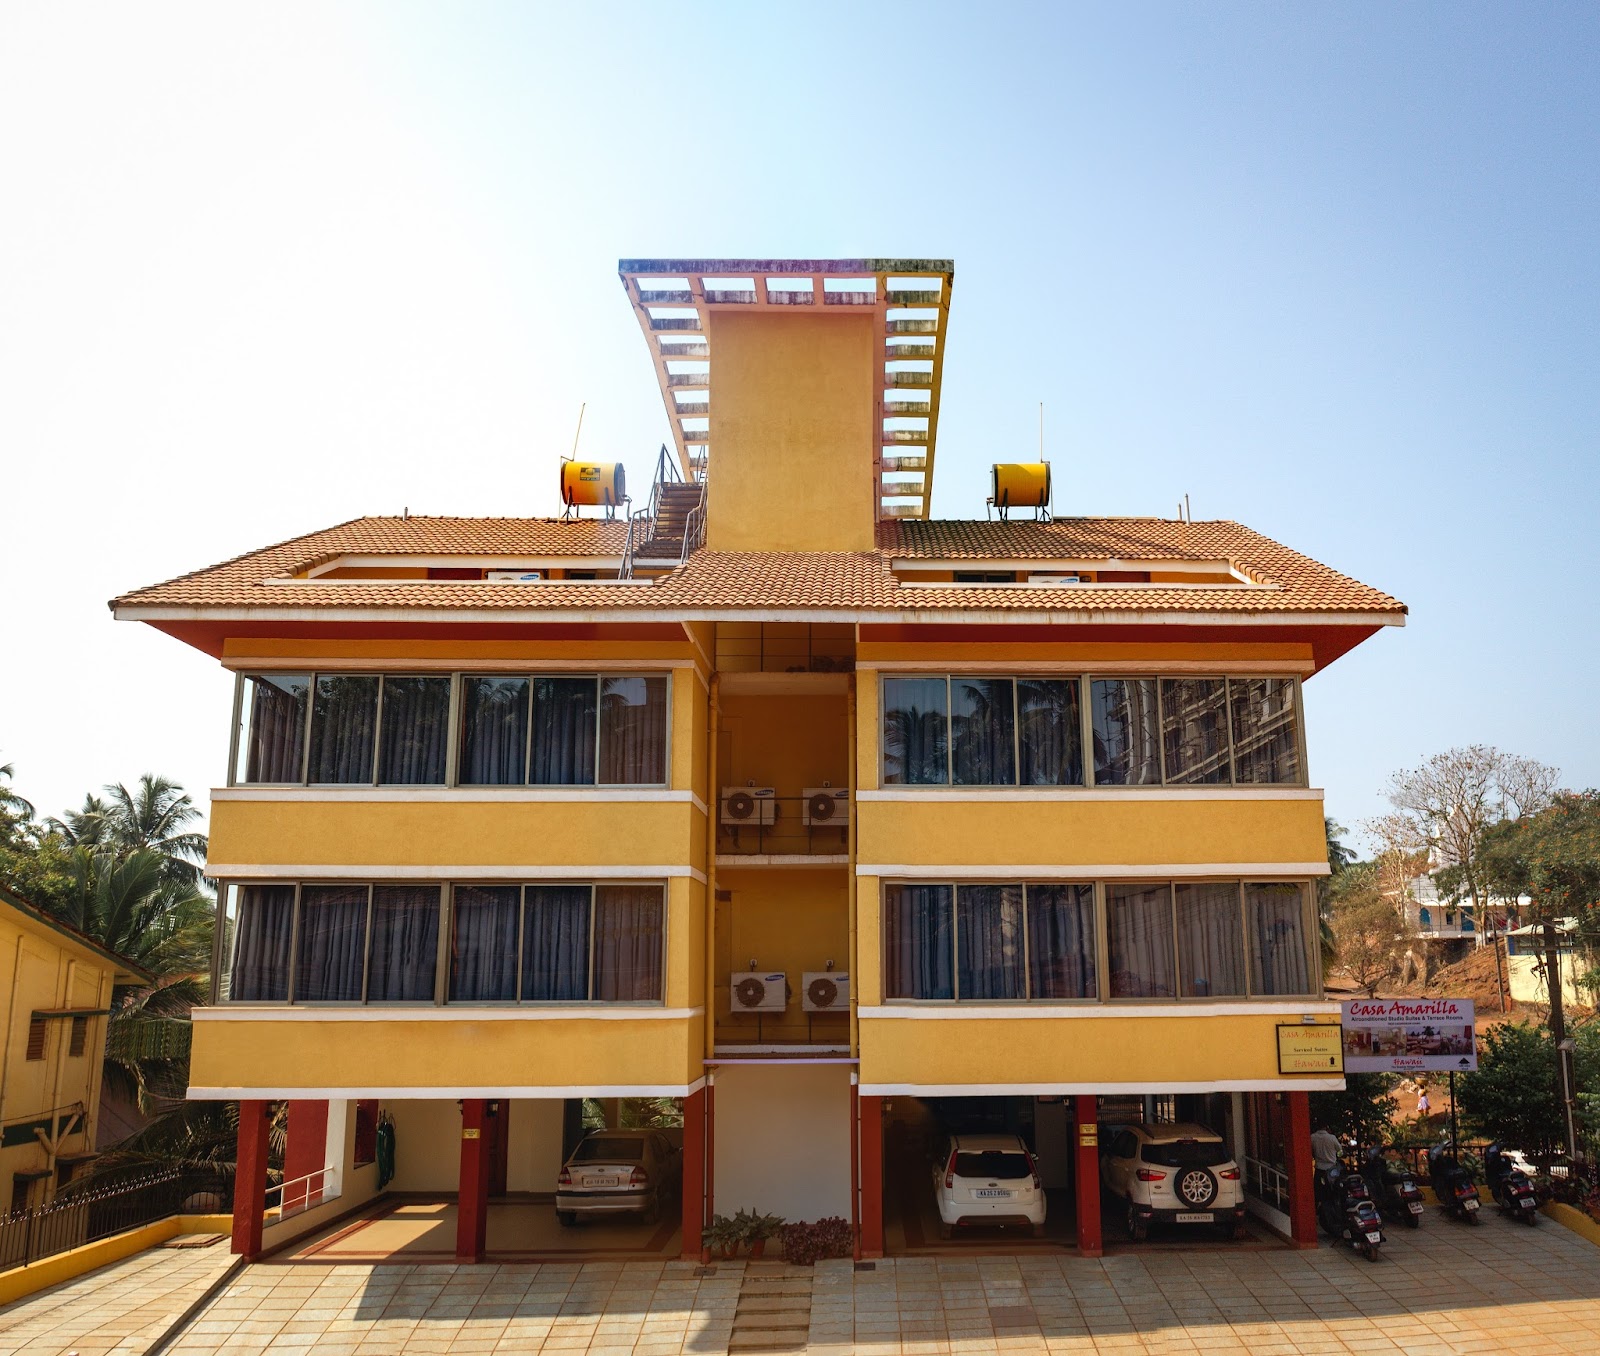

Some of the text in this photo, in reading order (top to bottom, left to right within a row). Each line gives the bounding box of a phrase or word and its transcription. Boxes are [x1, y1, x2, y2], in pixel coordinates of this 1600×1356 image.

[1350, 1000, 1459, 1015] Casa Amarilla
[1280, 1029, 1339, 1039] Casa Amarilla
[1294, 1059, 1328, 1068] Hawaii
[1393, 1057, 1423, 1065] Hawaii
